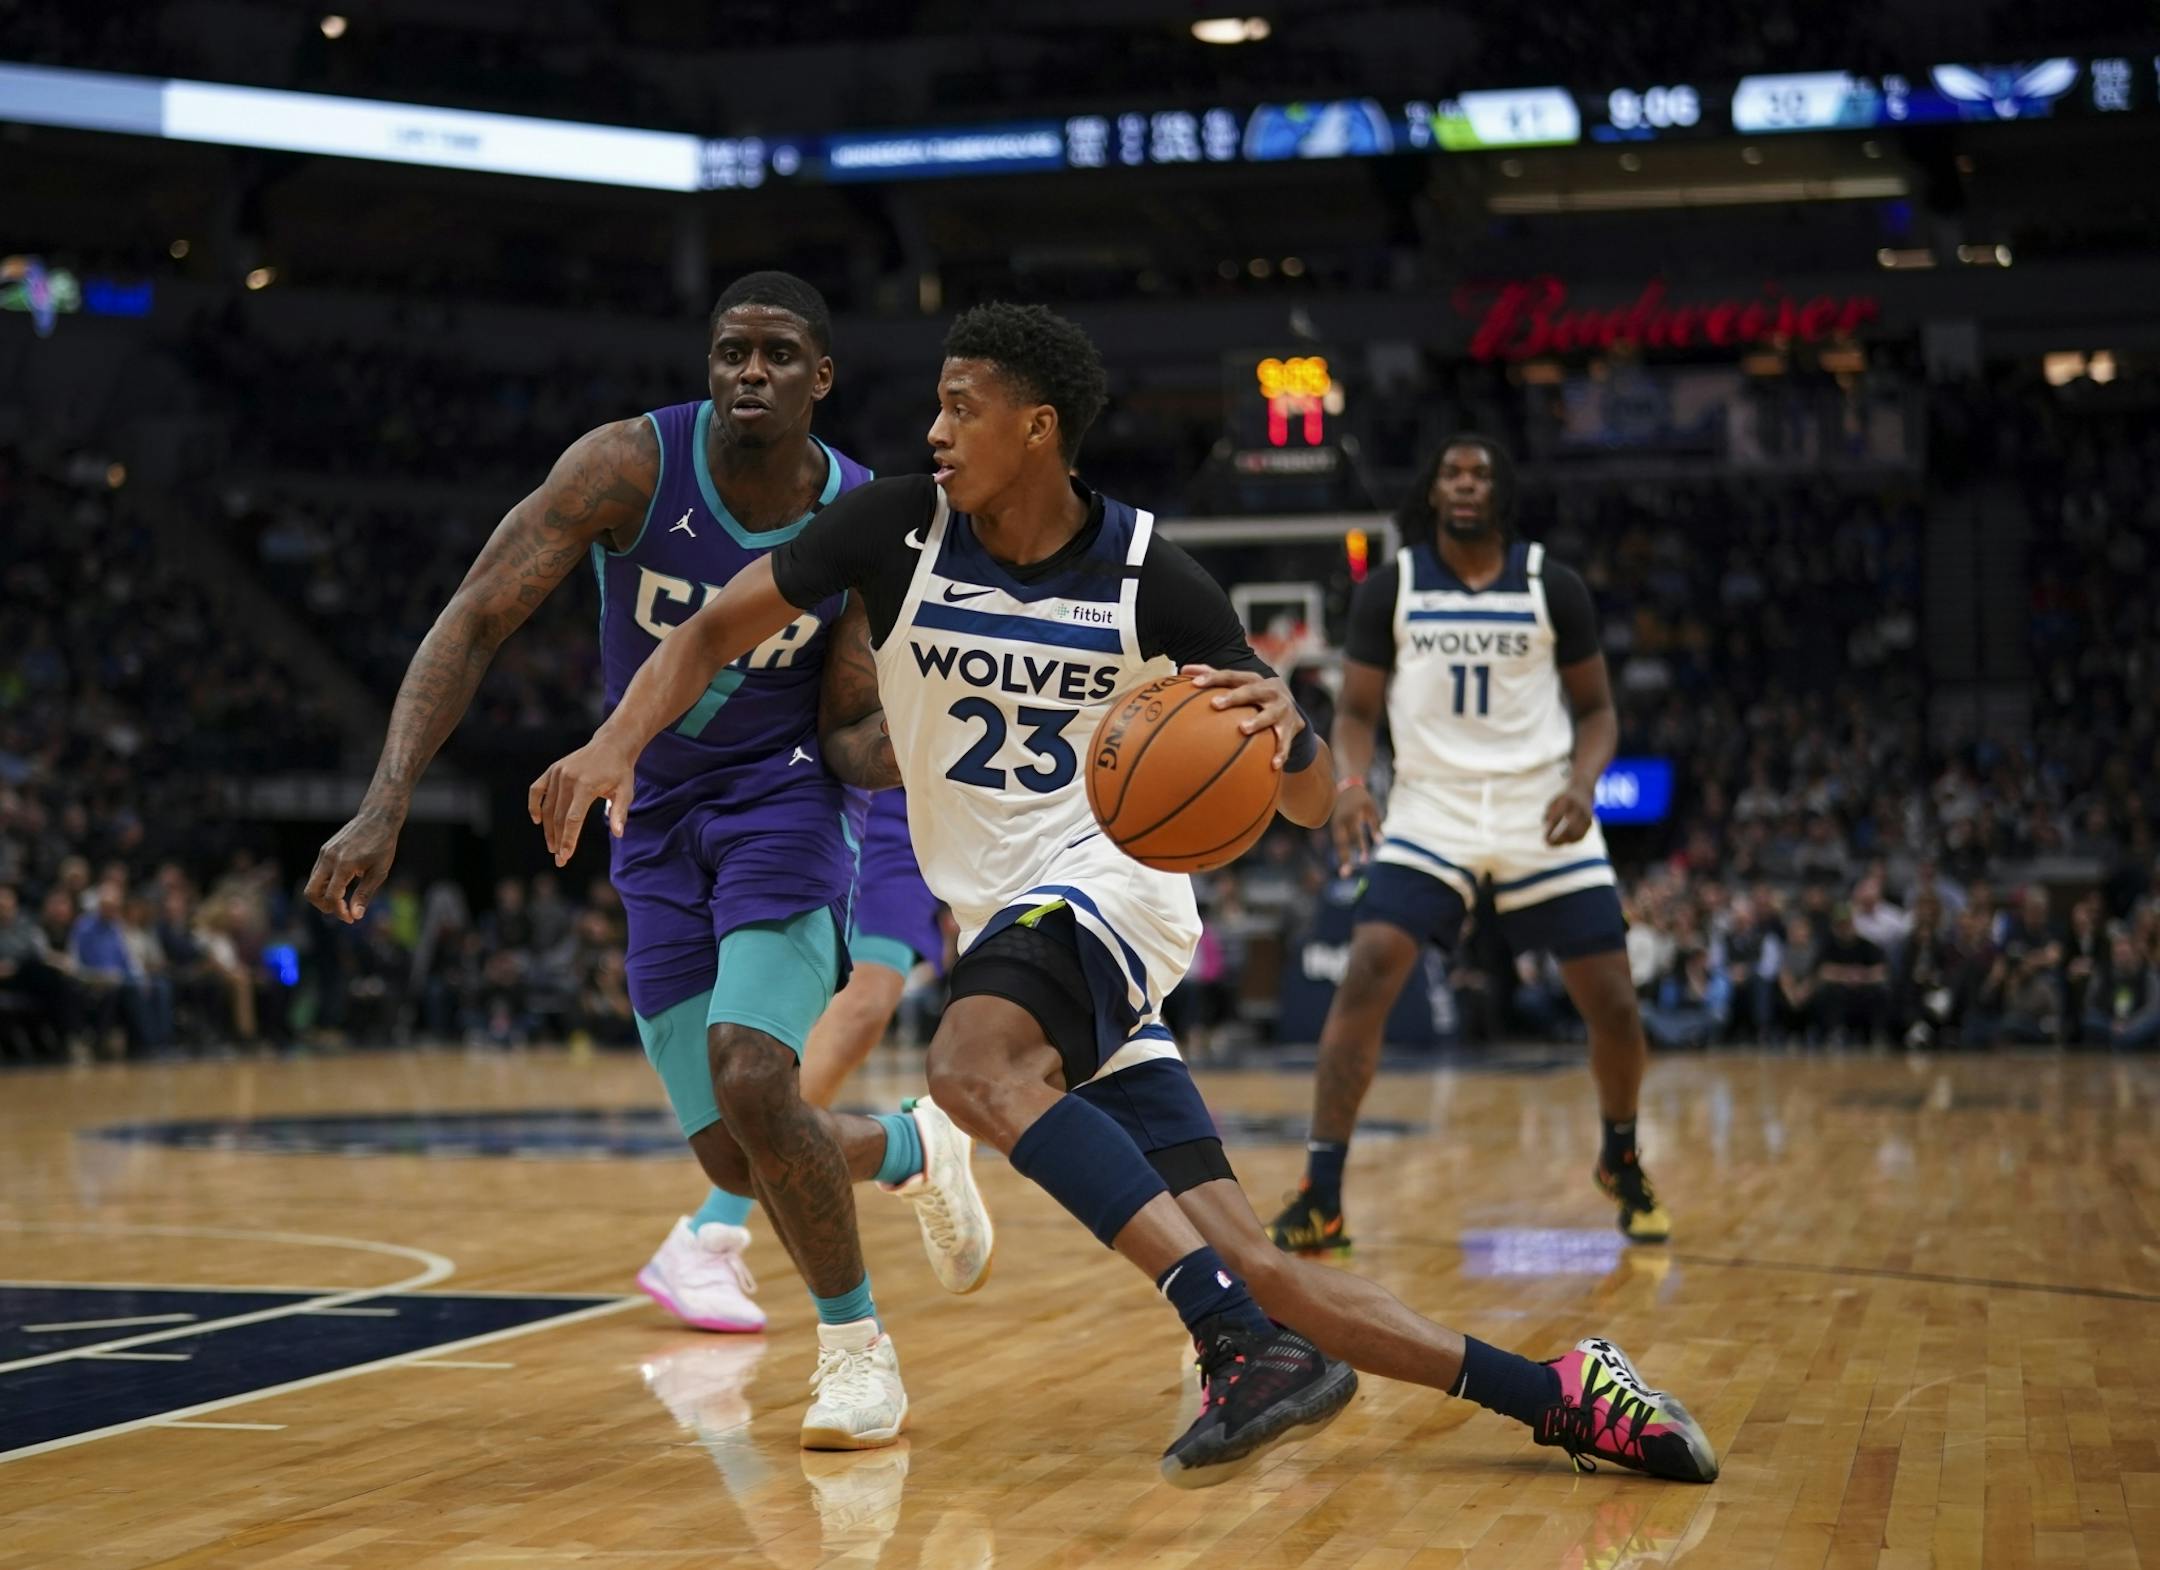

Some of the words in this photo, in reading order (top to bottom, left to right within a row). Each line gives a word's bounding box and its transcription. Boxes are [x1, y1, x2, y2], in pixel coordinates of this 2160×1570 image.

[1456, 274, 1879, 361] Budweiser
[634, 565, 822, 669] CA
[1073, 606, 1112, 624] fitbit
[1411, 632, 1529, 656] WOLVES
[910, 641, 1120, 700] WOLVES
[1448, 665, 1490, 717] 11
[946, 696, 1078, 794] 23
[1097, 675, 1194, 771] PALDING
